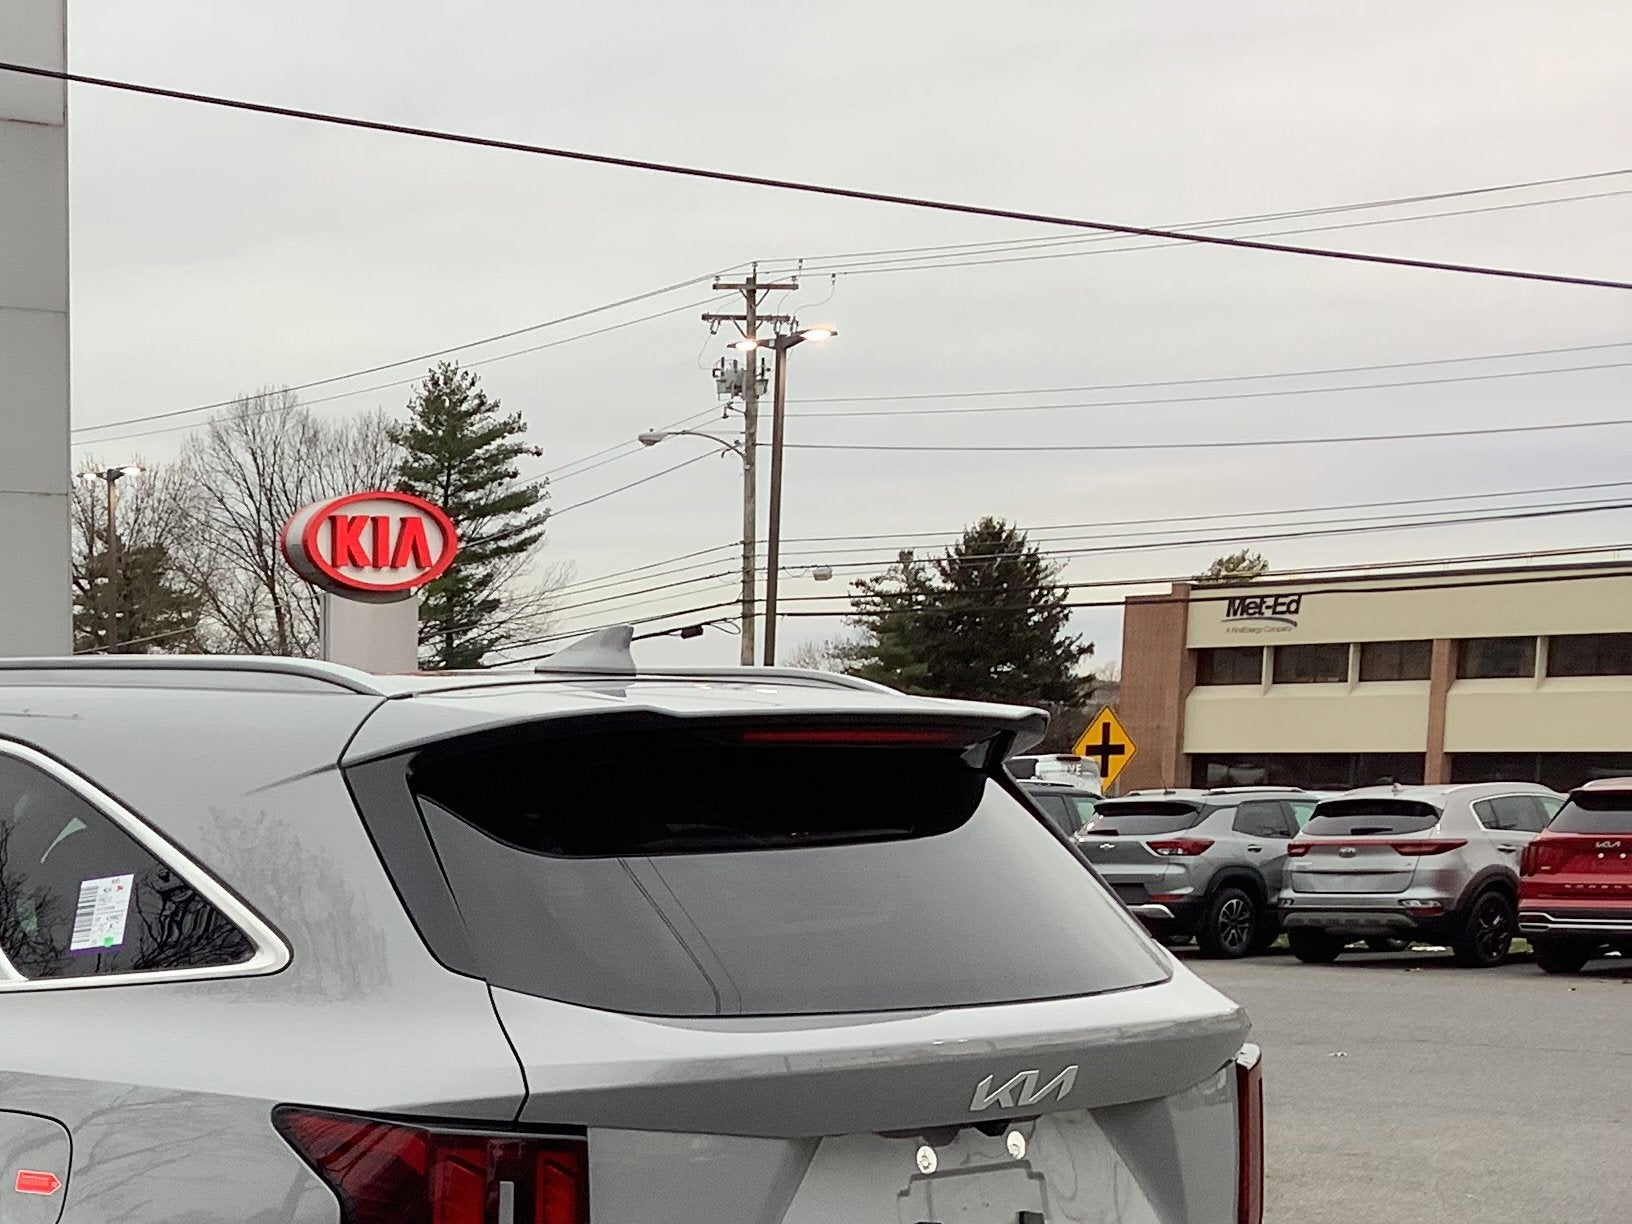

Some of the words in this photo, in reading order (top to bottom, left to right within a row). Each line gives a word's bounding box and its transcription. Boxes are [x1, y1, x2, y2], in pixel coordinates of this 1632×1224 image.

[329, 515, 433, 569] KIA
[1226, 594, 1302, 617] Met-Ed
[970, 1065, 1079, 1111] KIA
